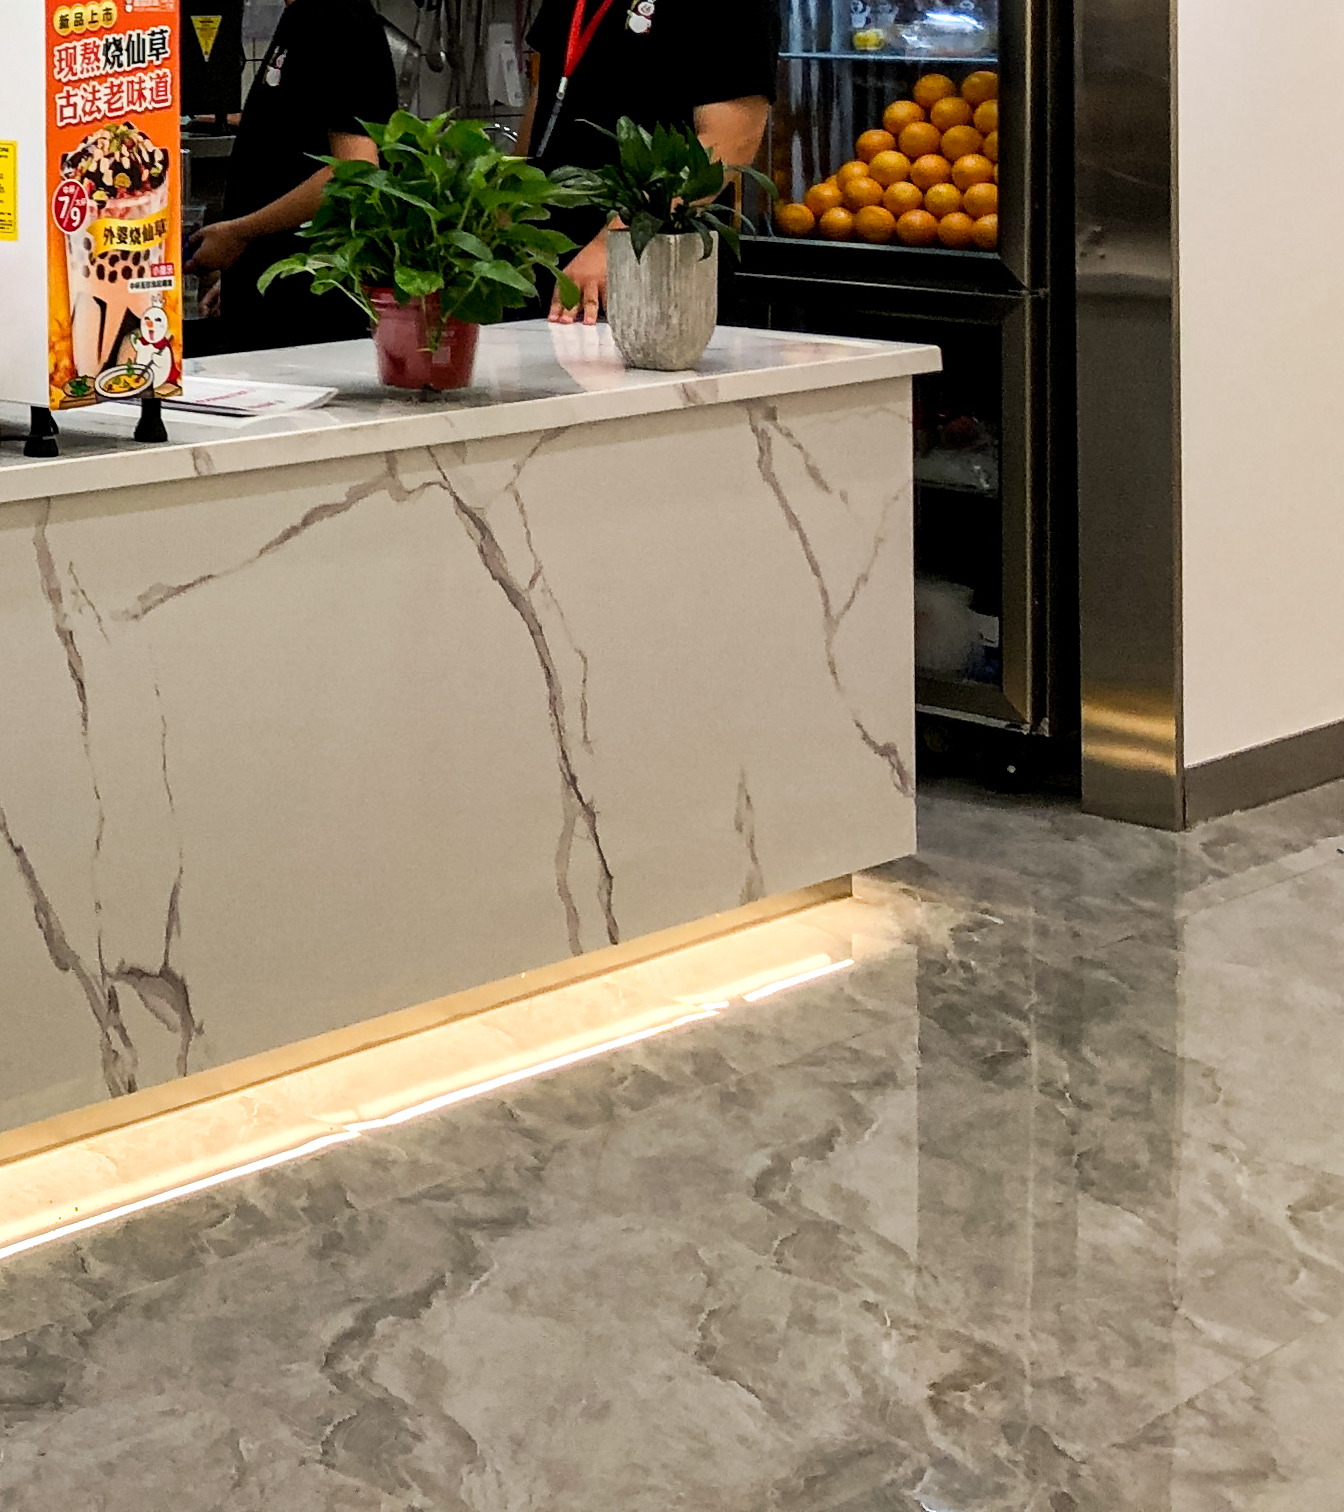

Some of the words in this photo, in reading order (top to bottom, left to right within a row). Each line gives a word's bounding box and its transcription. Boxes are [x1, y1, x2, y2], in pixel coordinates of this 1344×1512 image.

[58, 6, 115, 30] 新品上市
[56, 29, 169, 78] 现熬烧仙草
[57, 73, 172, 124] 古法老味道
[103, 217, 166, 246] 外婆烧仙草
